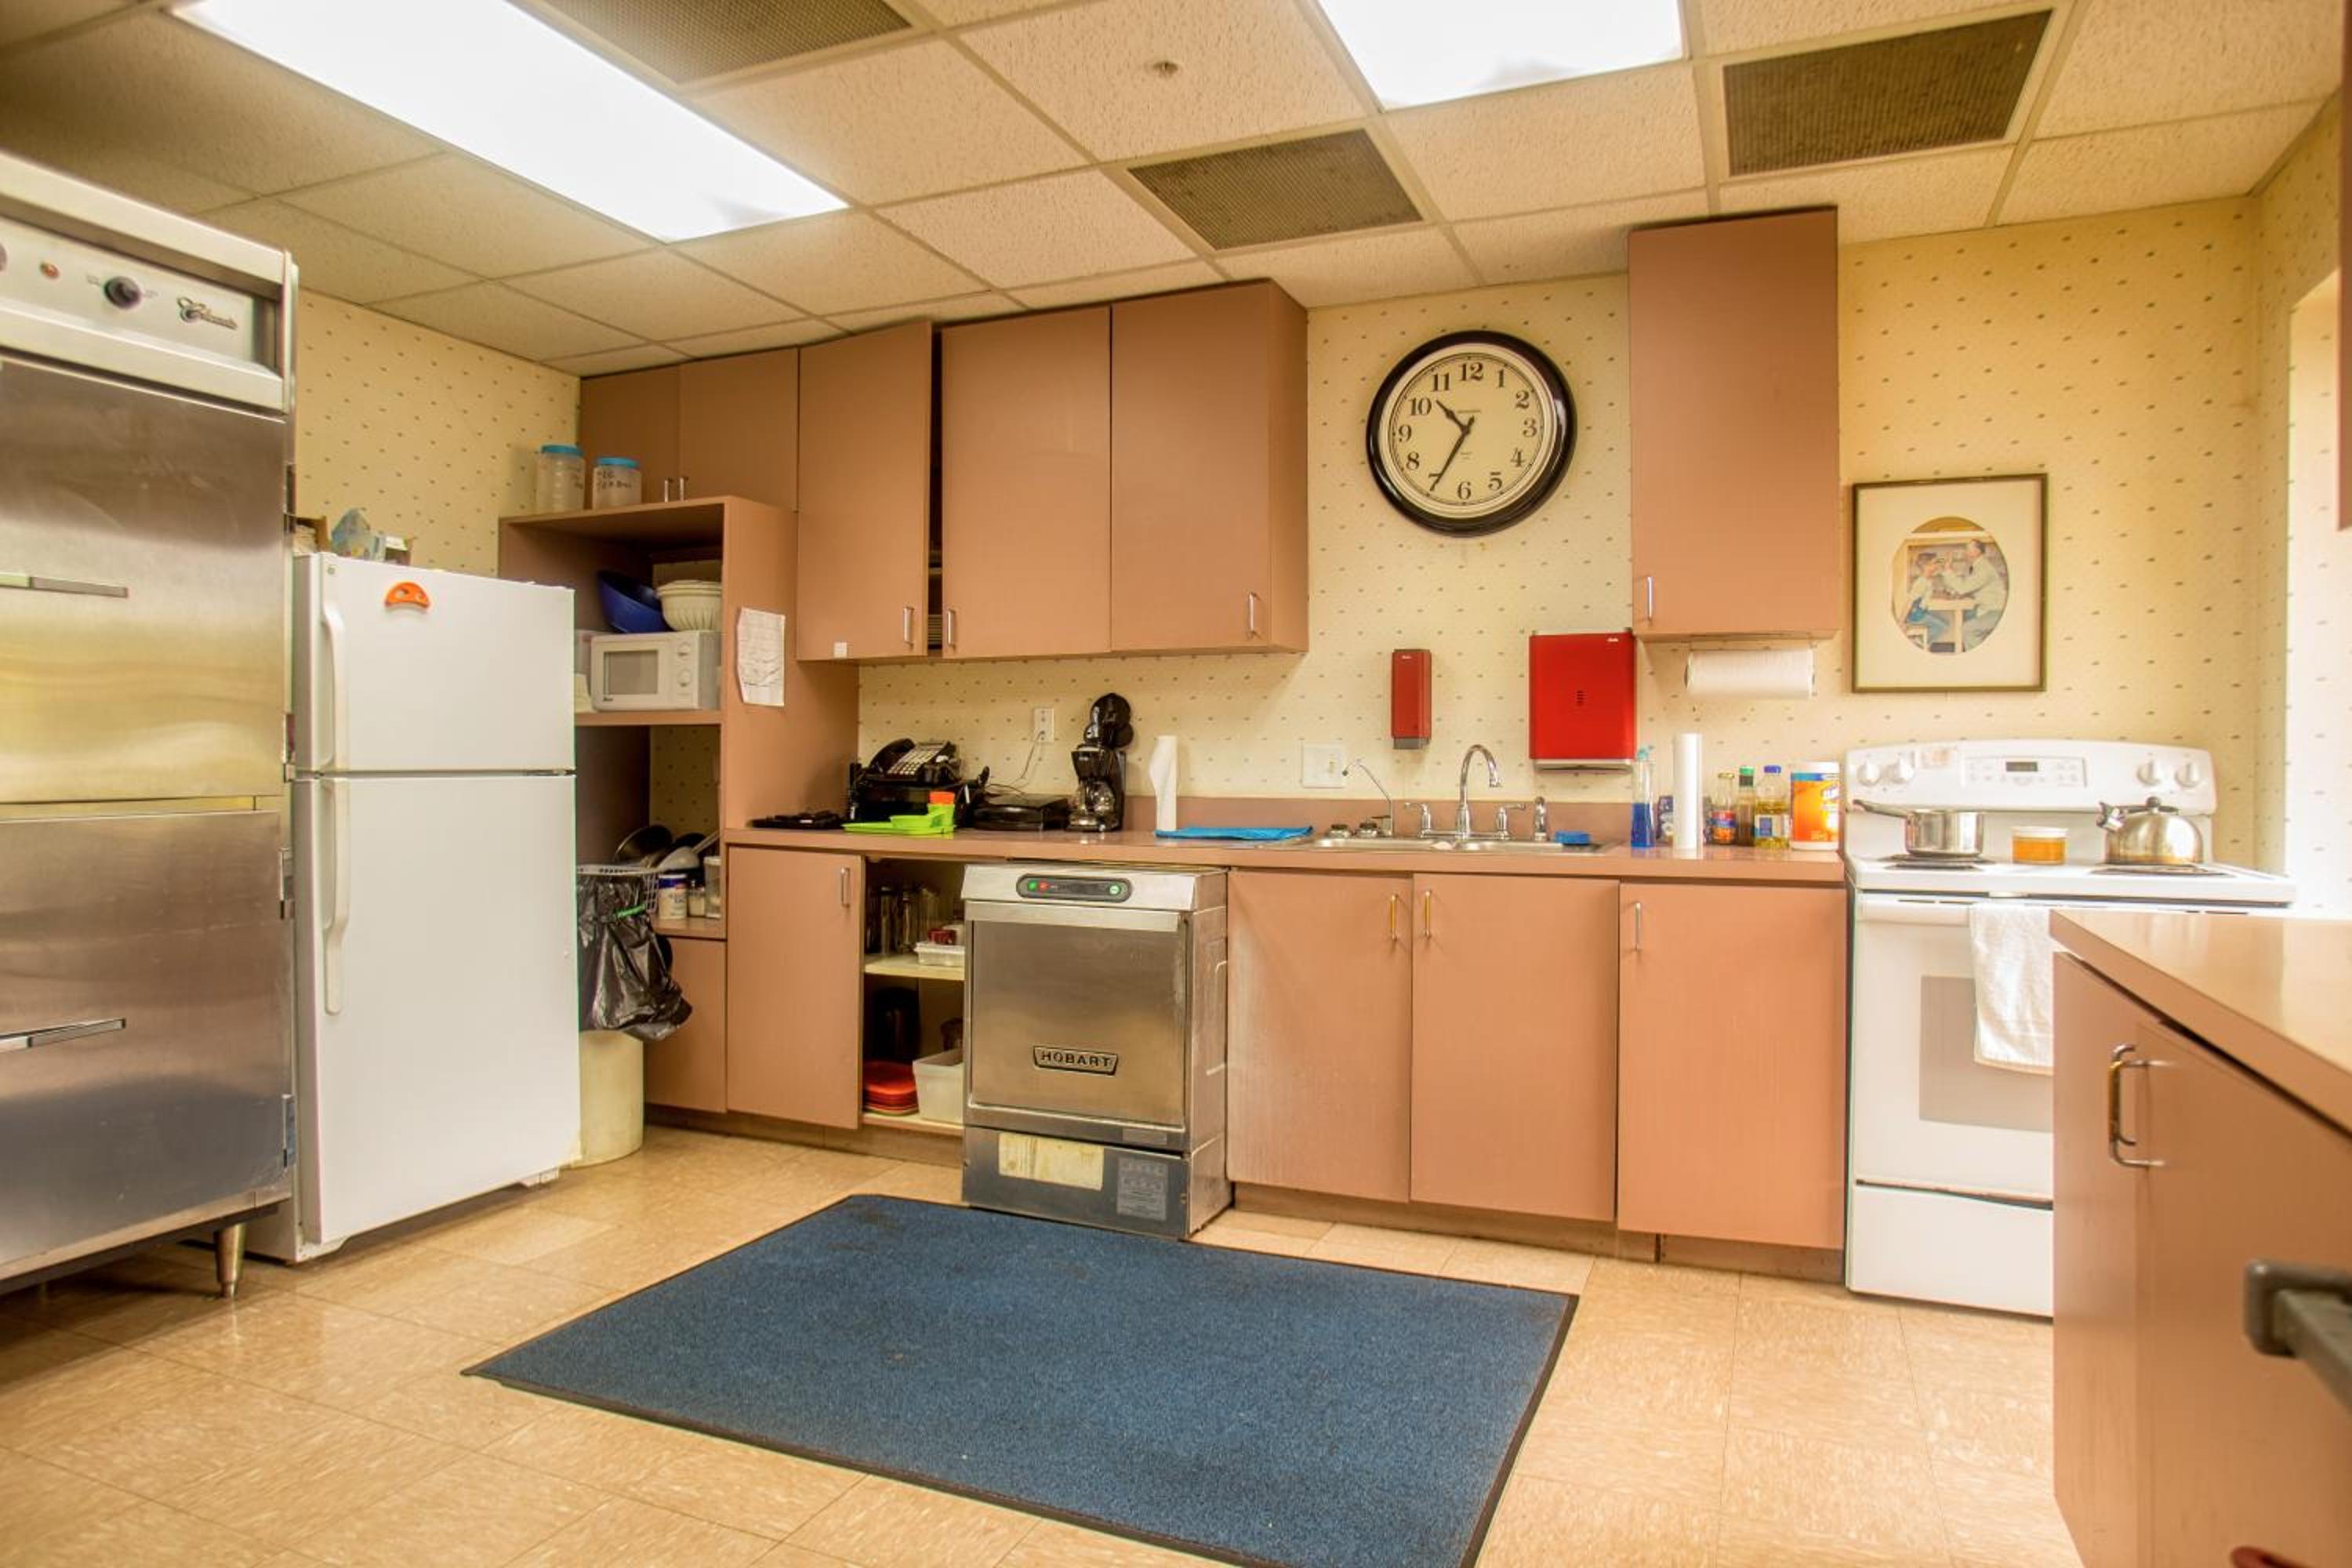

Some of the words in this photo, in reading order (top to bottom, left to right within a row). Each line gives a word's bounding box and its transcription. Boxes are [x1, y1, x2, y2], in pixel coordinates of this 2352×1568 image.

[1458, 361, 1484, 381] 12
[1497, 370, 1505, 387] 1
[1432, 373, 1450, 391] 11
[1409, 397, 1432, 416] 10
[1515, 390, 1530, 408] 2
[1399, 424, 1411, 441] 9
[1523, 420, 1537, 437] 3
[1406, 452, 1420, 470] 8
[1510, 448, 1524, 467] 4
[1428, 473, 1440, 492] 7
[1457, 481, 1471, 499] 6
[1488, 472, 1502, 490] 5
[1041, 1051, 1111, 1067] HOBART
